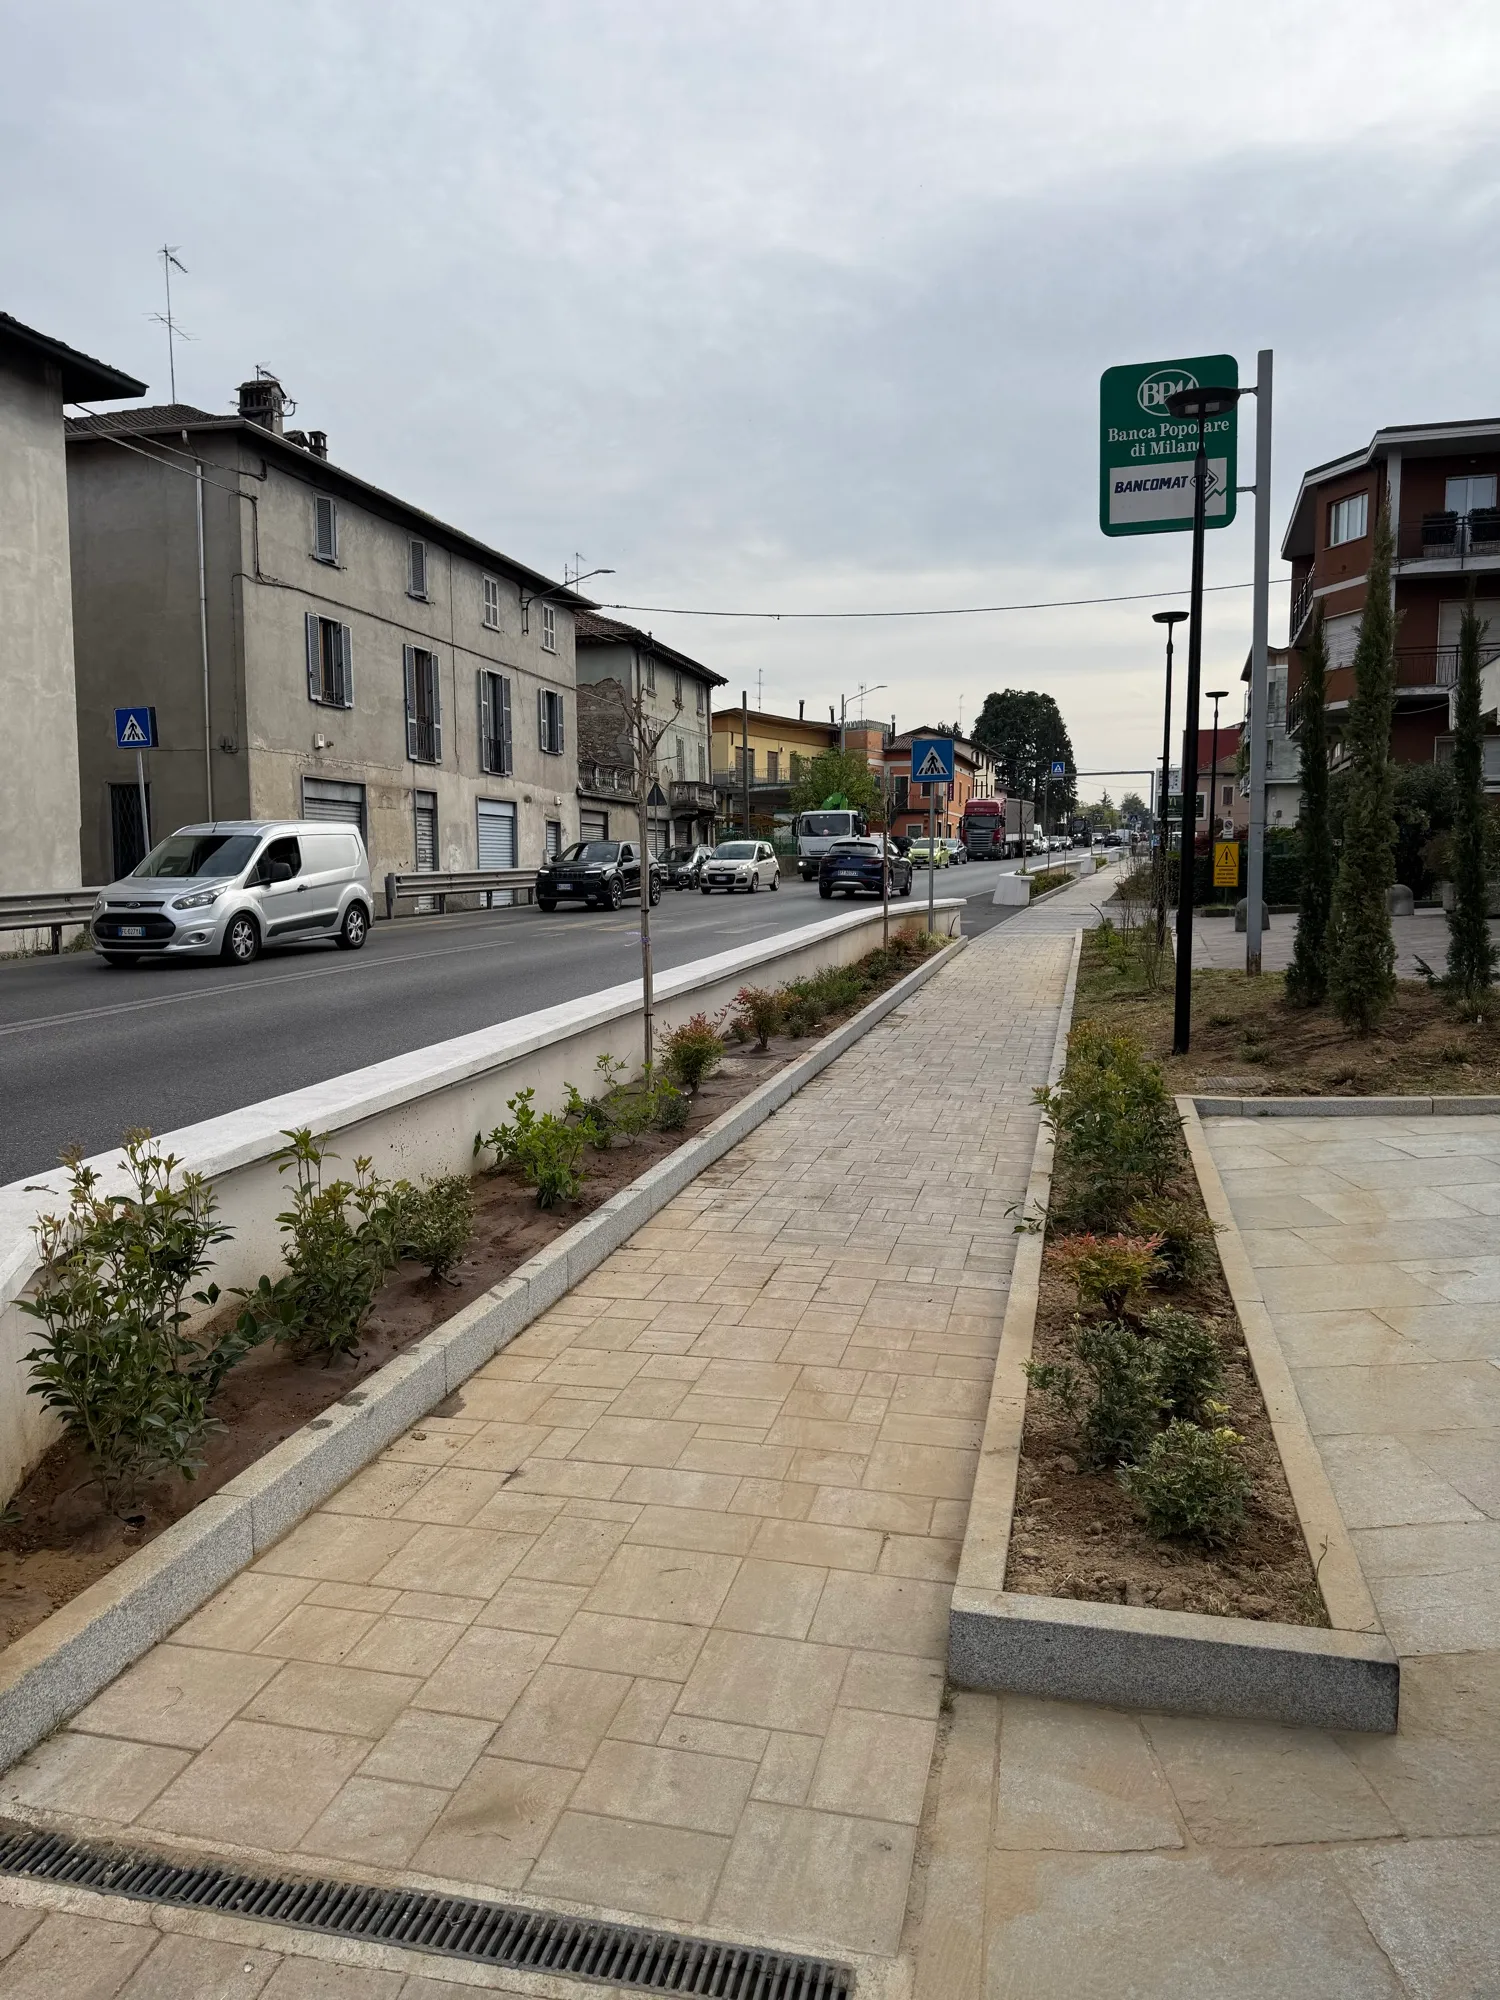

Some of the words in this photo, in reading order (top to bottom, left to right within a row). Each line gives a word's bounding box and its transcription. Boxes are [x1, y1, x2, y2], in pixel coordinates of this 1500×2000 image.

[1108, 427, 1157, 442] Banca
[1130, 443, 1146, 457] di
[1114, 475, 1189, 494] BANCOMAT
